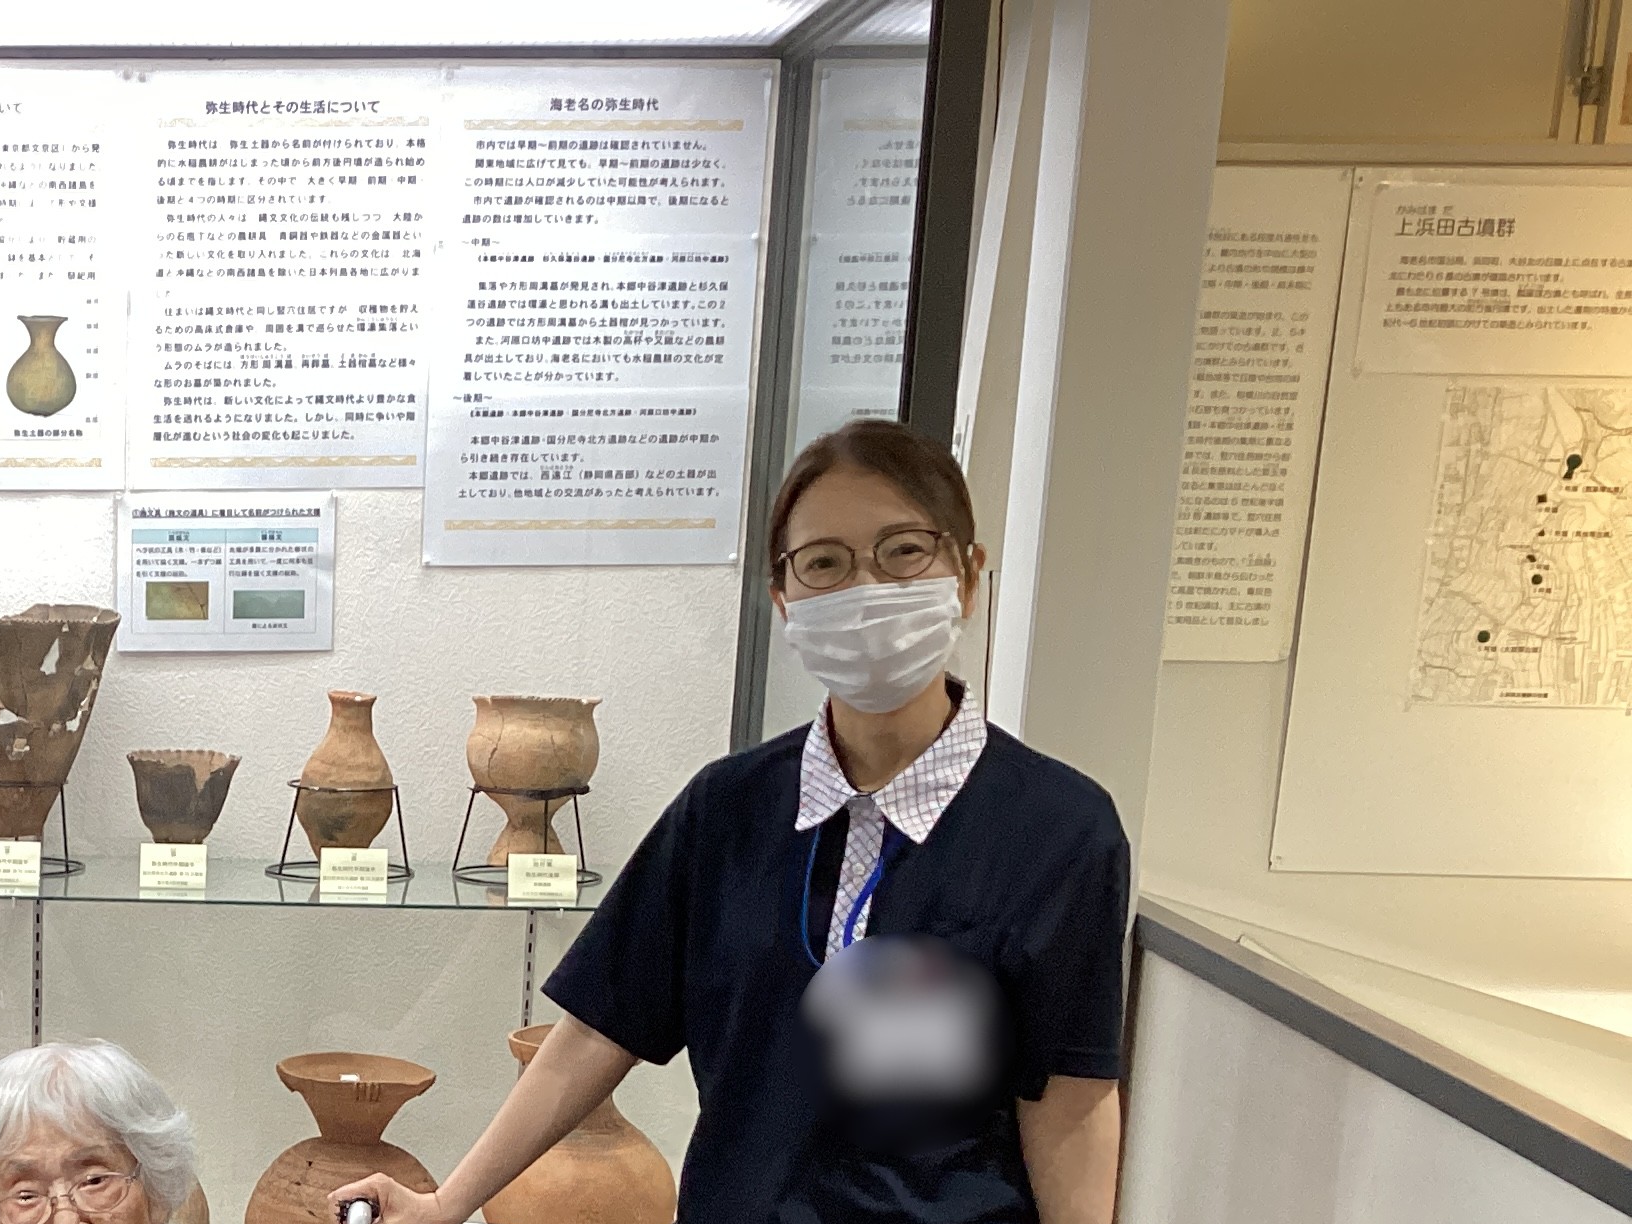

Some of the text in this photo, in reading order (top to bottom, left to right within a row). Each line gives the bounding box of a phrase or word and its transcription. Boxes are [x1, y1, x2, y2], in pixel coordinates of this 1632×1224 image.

[205, 100, 381, 114] 弥生時代とその生活について
[549, 97, 660, 112] 海老名の弥生時代
[1394, 216, 1516, 237] 上浜田古墳群
